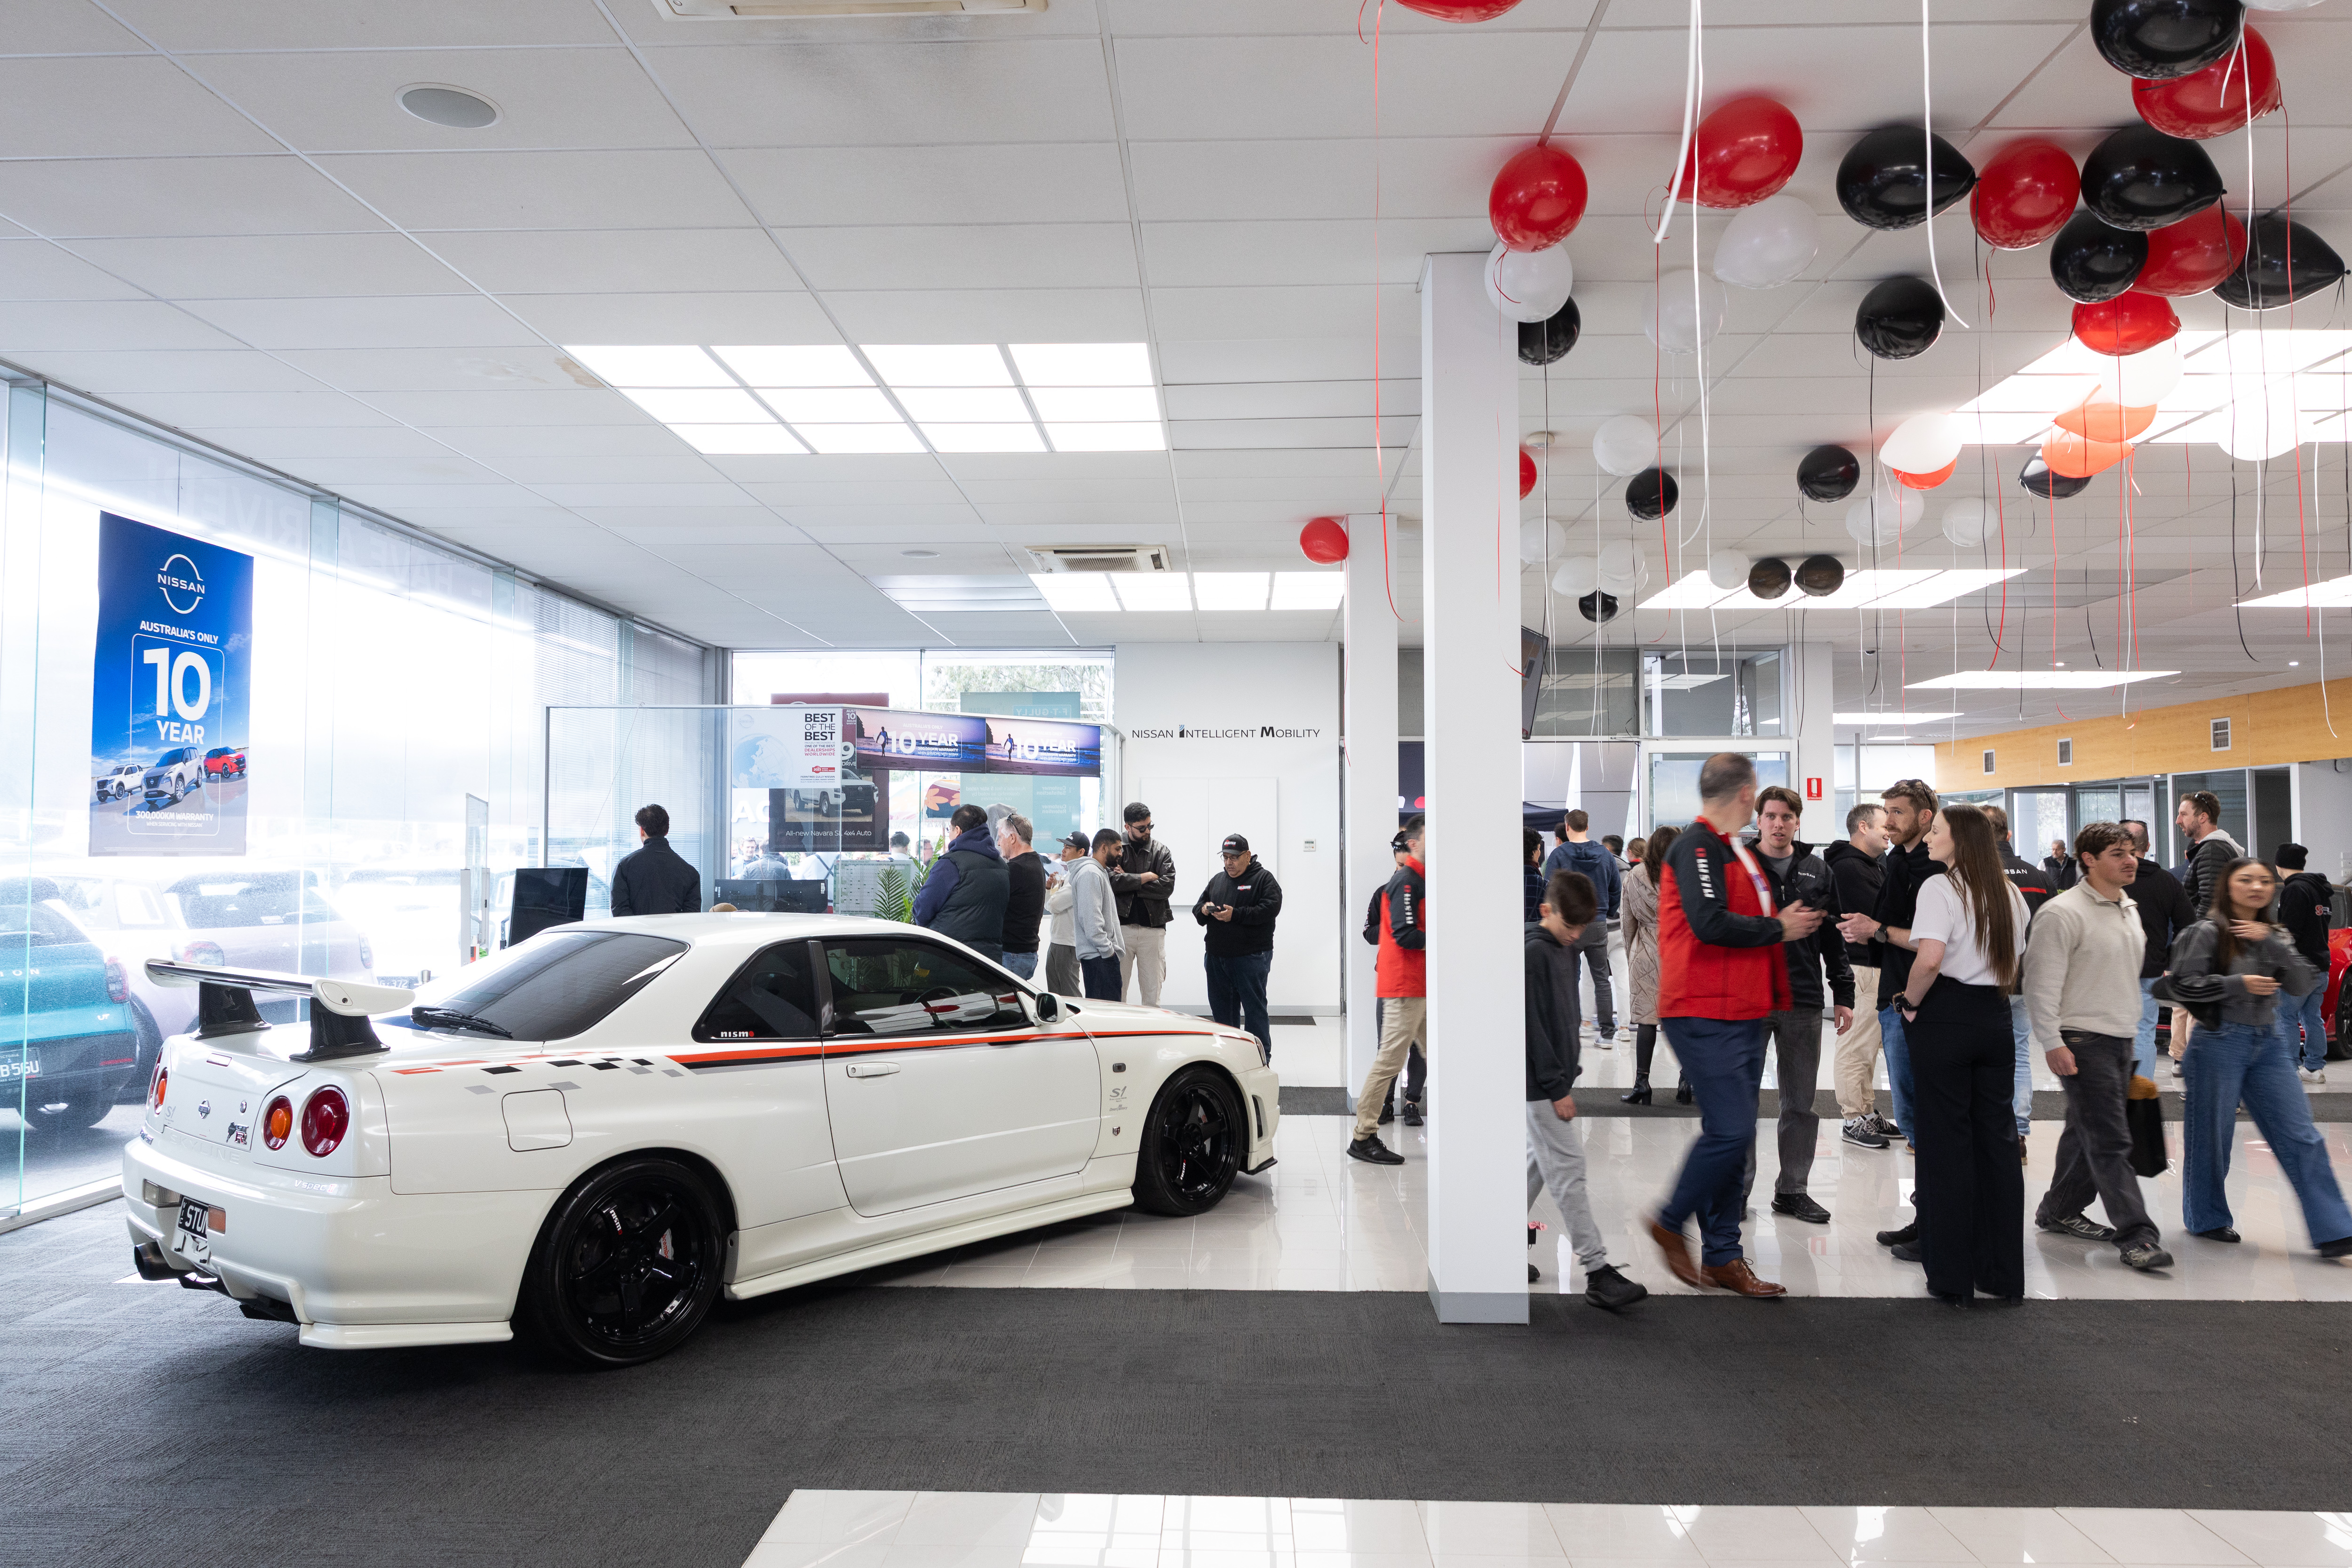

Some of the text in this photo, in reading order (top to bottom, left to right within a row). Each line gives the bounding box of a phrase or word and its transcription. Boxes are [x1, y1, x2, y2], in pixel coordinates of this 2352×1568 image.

[157, 573, 205, 594] NISSAN
[140, 620, 219, 645] AUSTRALIA'S ONLY
[143, 647, 211, 721] 10
[805, 713, 835, 723] BEST
[156, 720, 205, 745] YEAR
[804, 732, 835, 740] BEST
[888, 730, 916, 754] 10
[918, 732, 959, 747] YEAR
[1132, 729, 1174, 738] NISSAN
[1014, 737, 1039, 759] 10
[1040, 738, 1076, 753] YEAR
[135, 811, 214, 821] 300,000KM WARRANTY
[169, 1133, 240, 1165] SKYLINE
[610, 1209, 623, 1235] nismo
